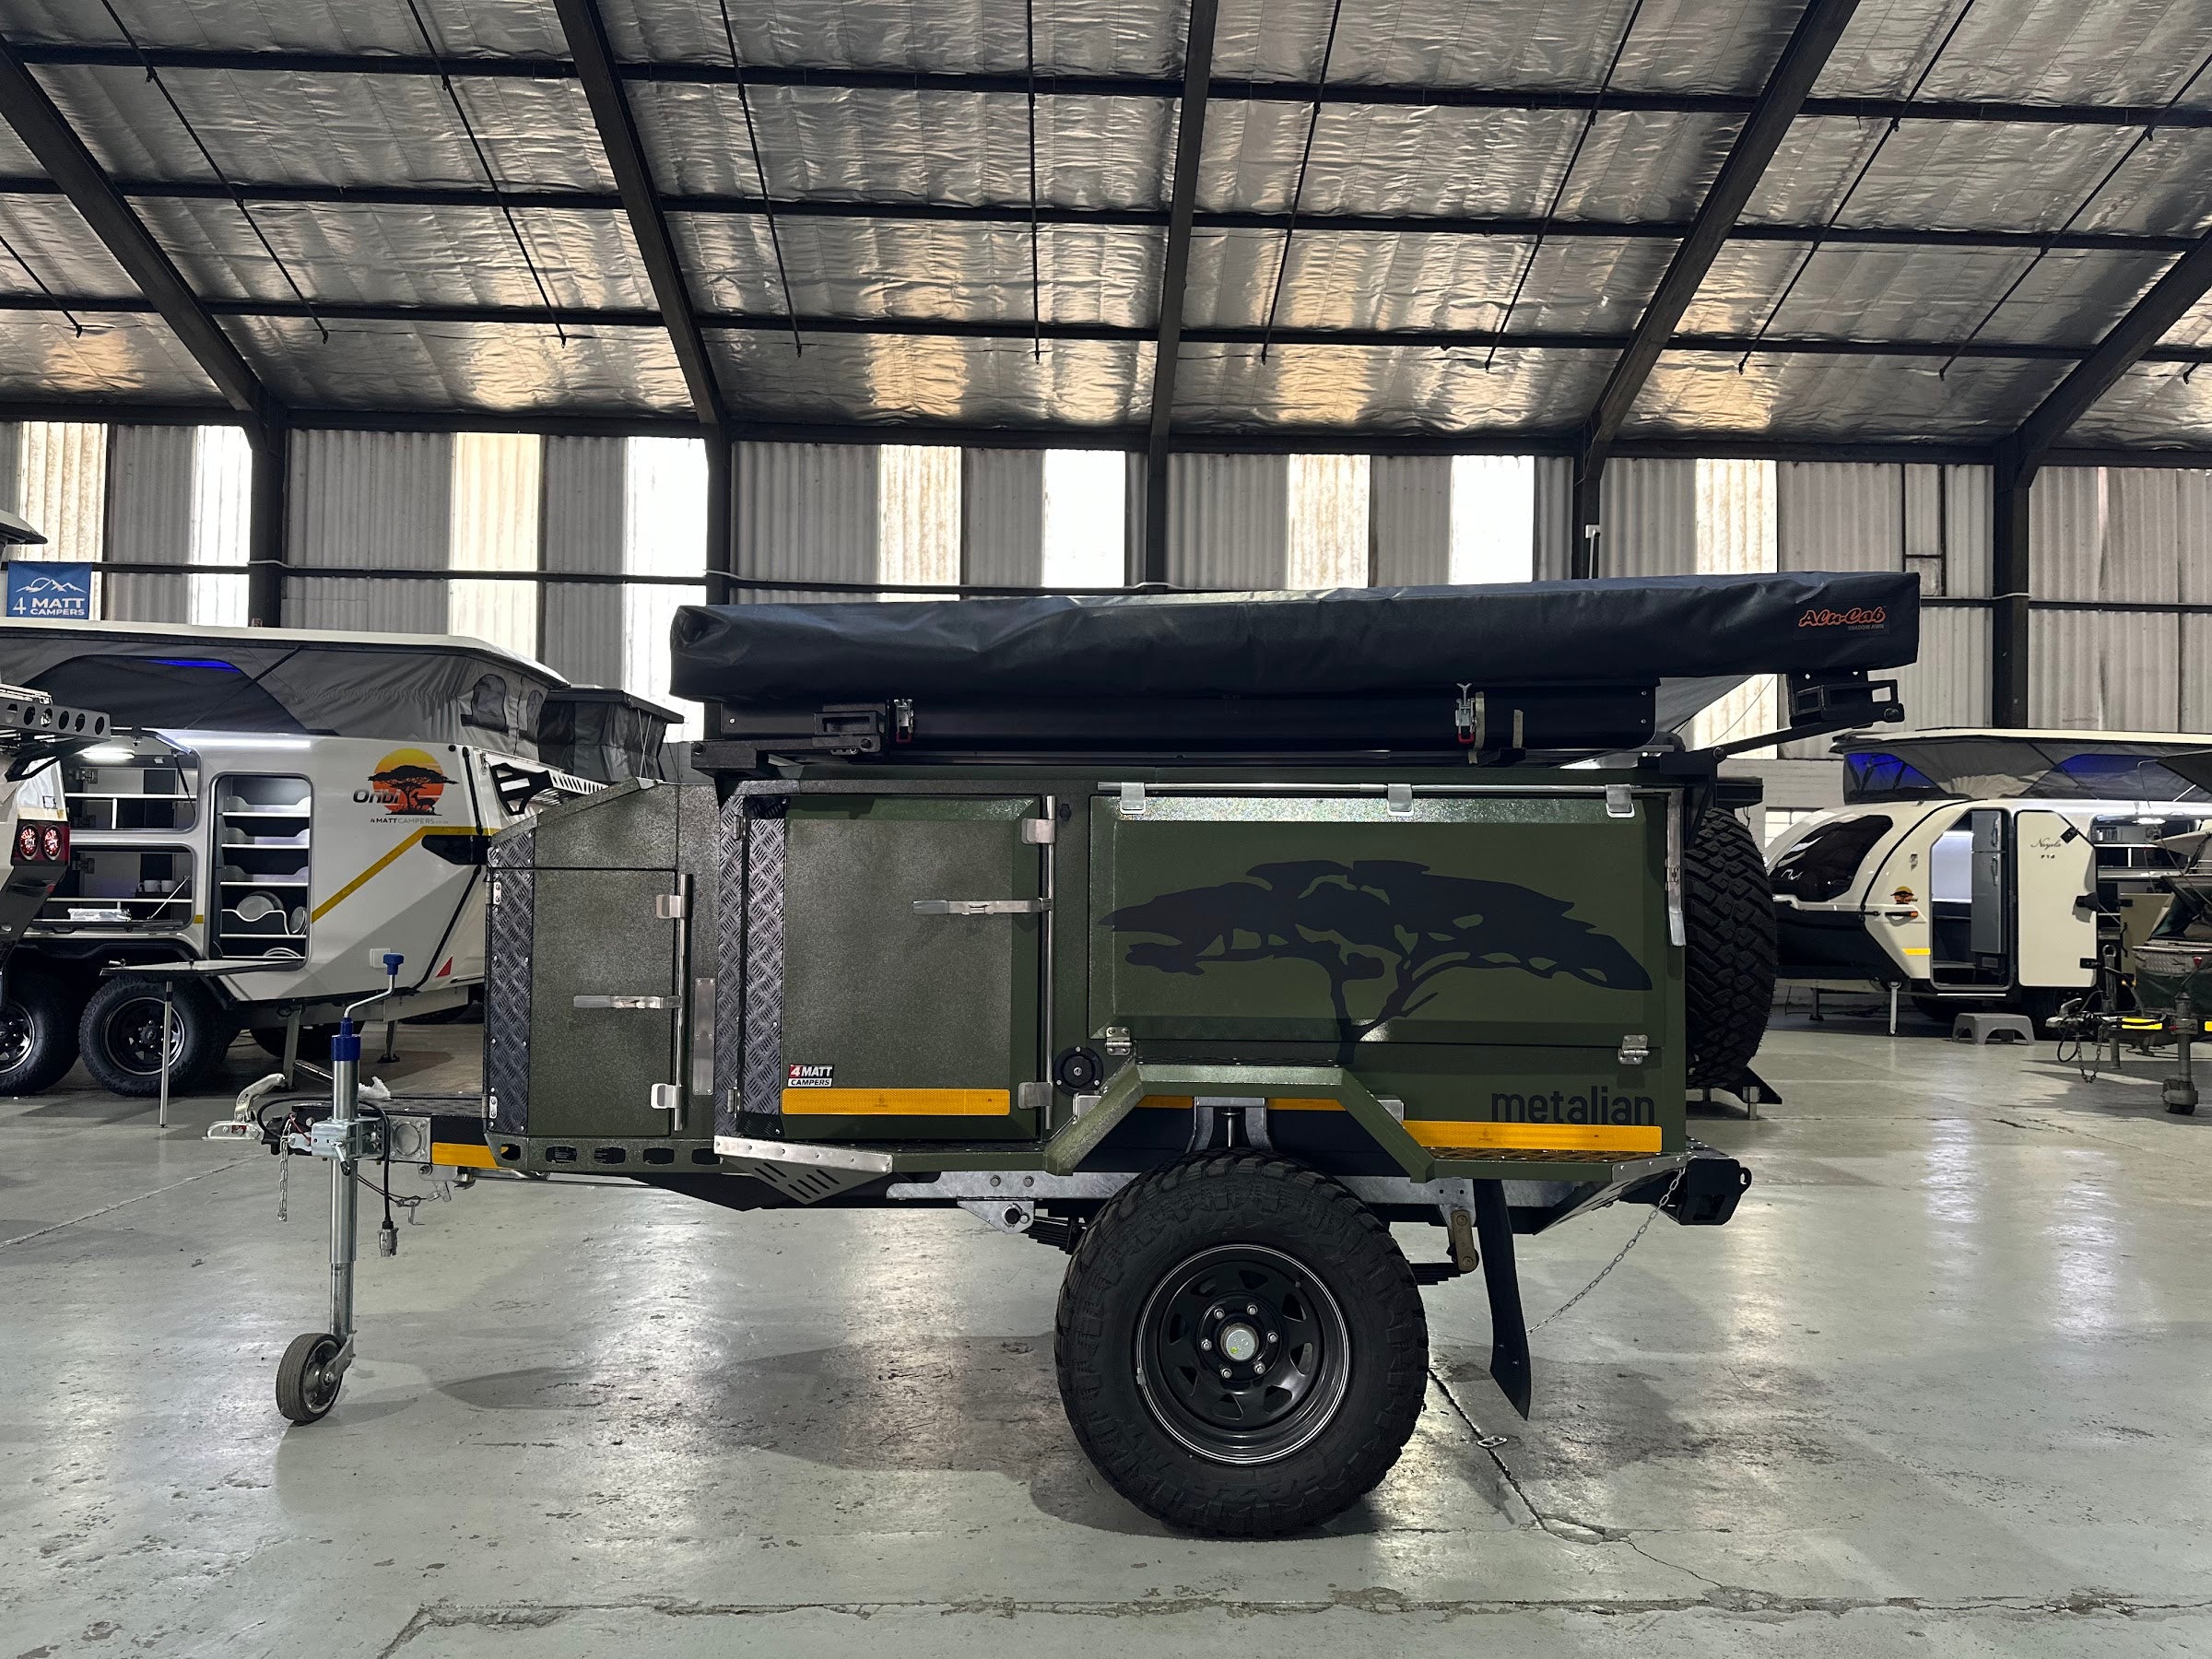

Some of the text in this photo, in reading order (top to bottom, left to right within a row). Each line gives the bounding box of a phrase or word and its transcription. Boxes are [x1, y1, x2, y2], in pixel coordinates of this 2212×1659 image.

[12, 596, 86, 615] 4 MATT
[1798, 606, 1886, 627] Alu-Cab
[1491, 1086, 1655, 1125] metalian
